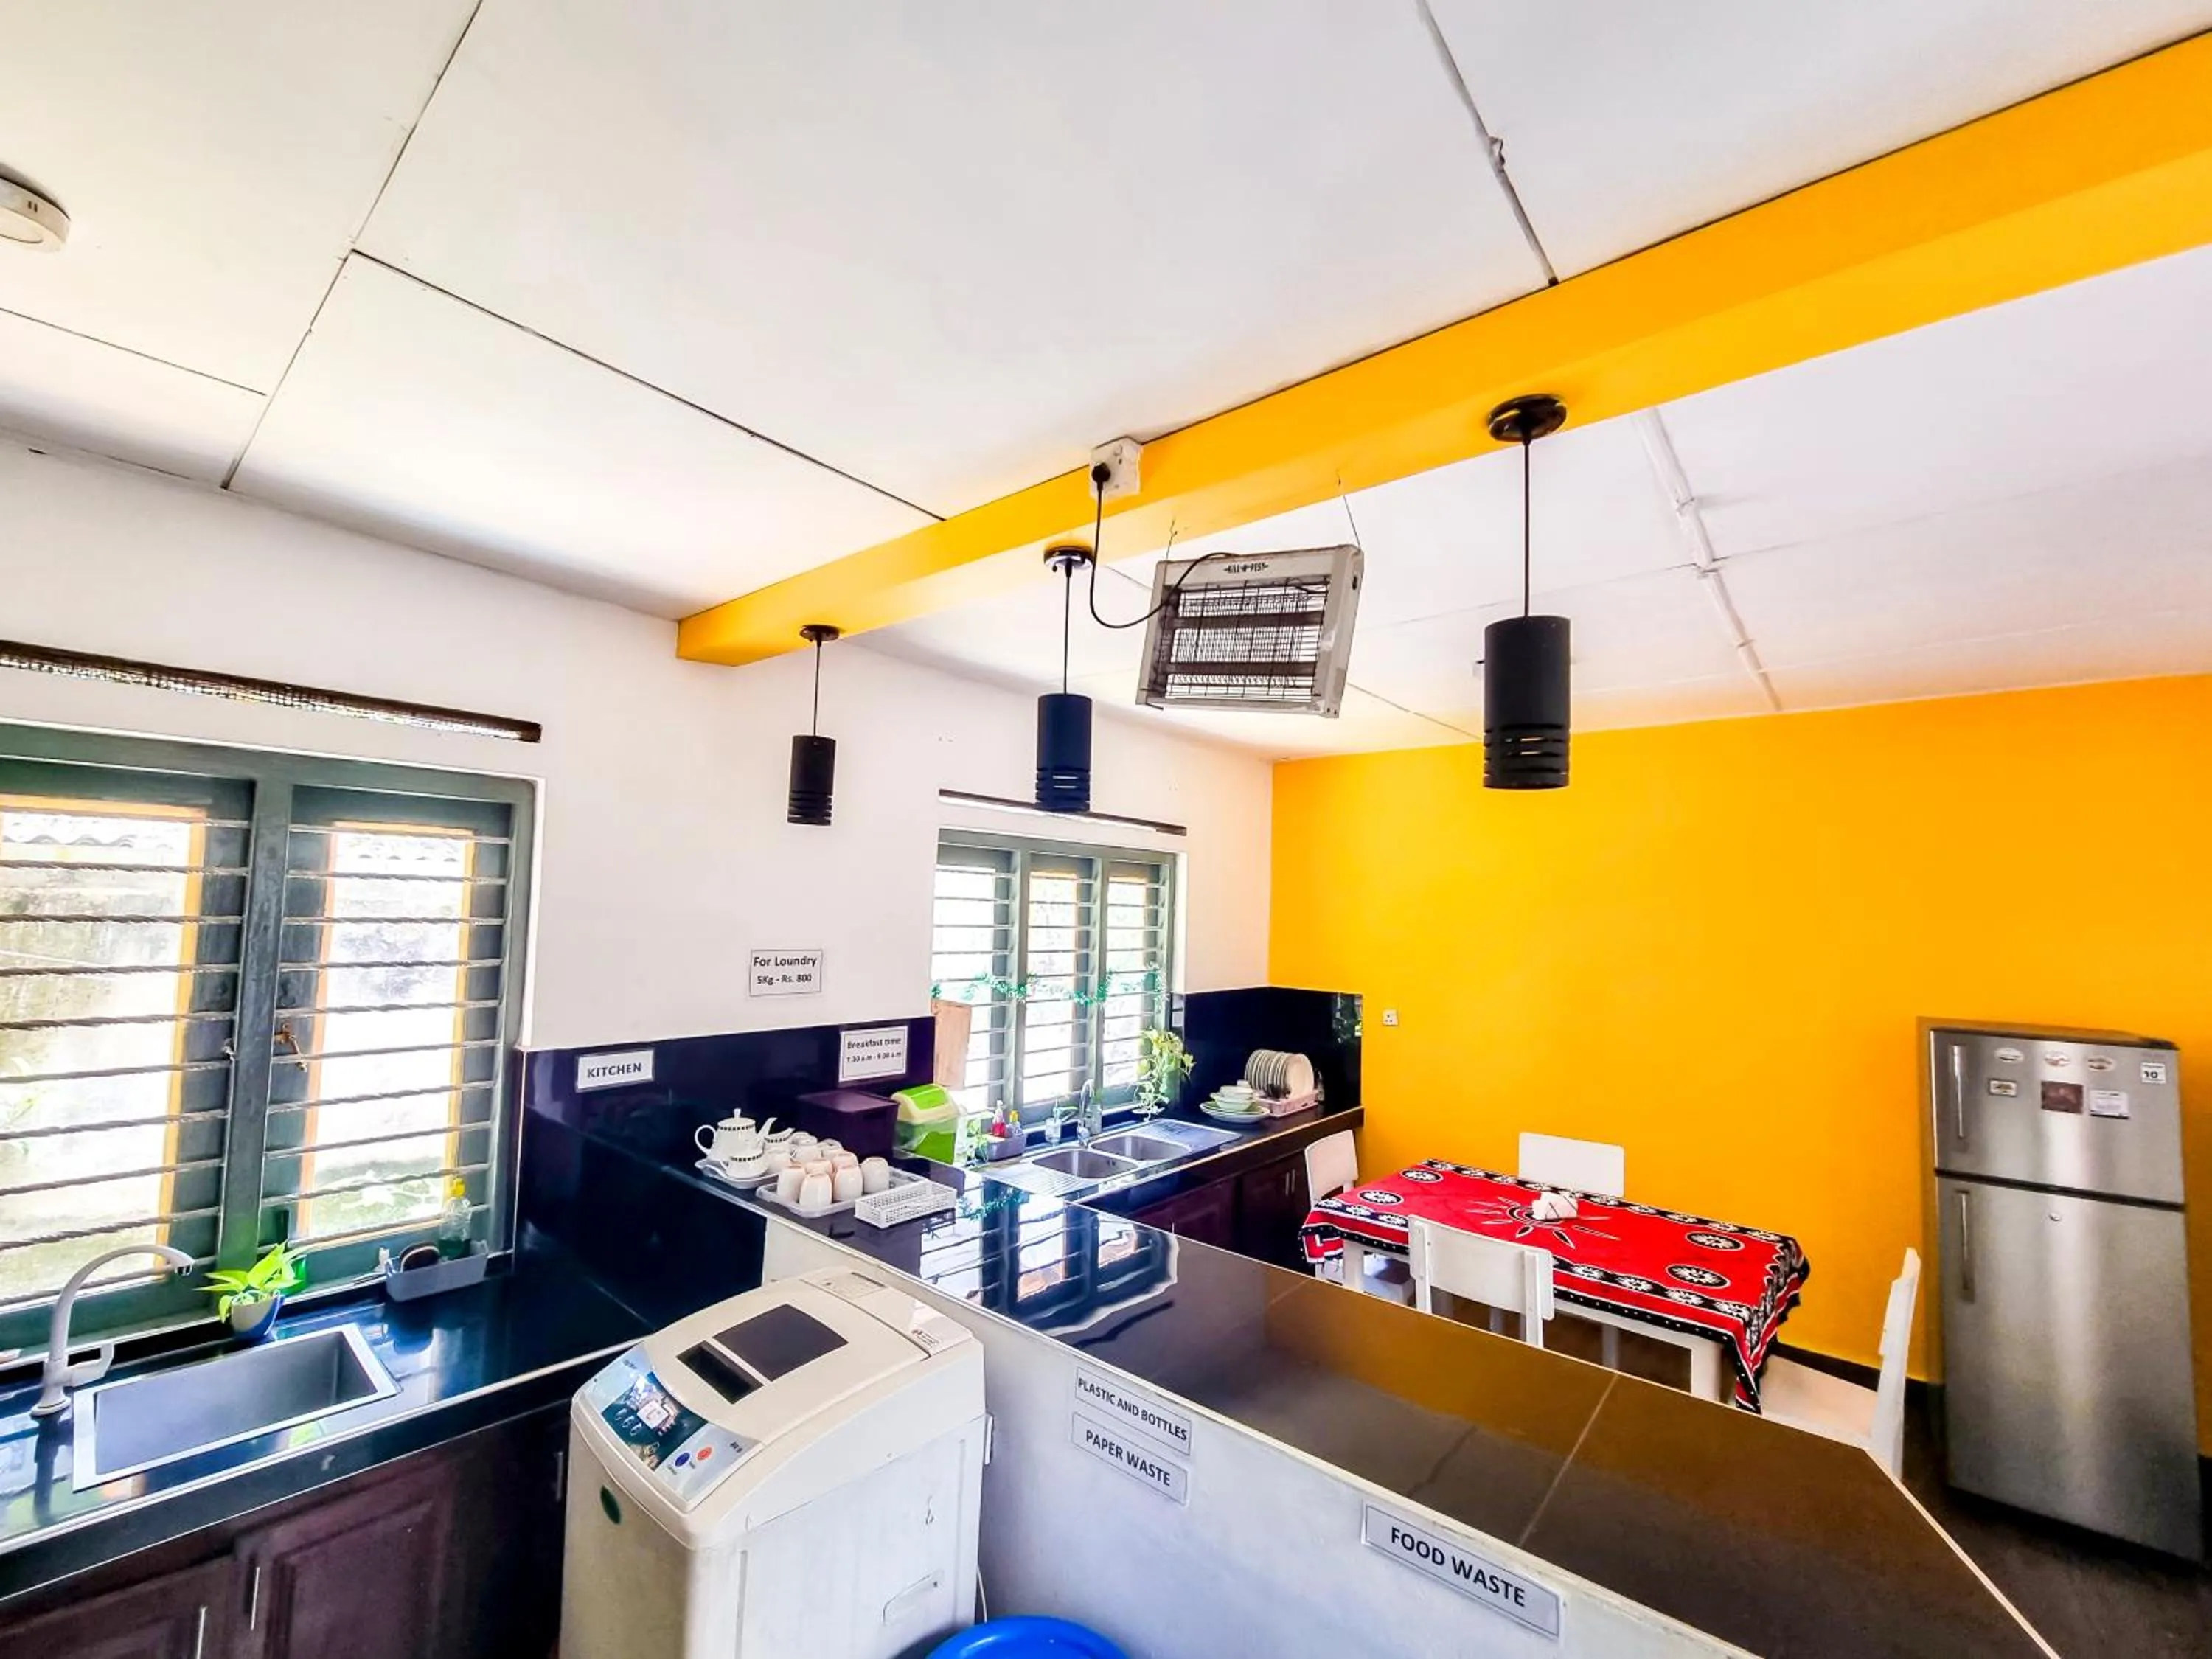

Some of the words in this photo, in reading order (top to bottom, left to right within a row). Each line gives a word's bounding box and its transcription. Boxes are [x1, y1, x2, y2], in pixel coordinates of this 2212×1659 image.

[754, 956, 771, 967] For
[774, 956, 817, 967] Loundry
[757, 975, 773, 986] 5Kg
[781, 974, 794, 983] Rs.
[796, 973, 812, 983] 800
[847, 1038, 883, 1049] Breakfast
[884, 1037, 901, 1046] time
[588, 1062, 641, 1079] KITCHEN
[1078, 1378, 1116, 1405] PLASTIC
[1117, 1398, 1139, 1416] AND
[1141, 1409, 1187, 1441] BOTTLES
[1086, 1430, 1123, 1461] PAPER
[1127, 1450, 1170, 1486] WASTE
[1391, 1527, 1445, 1565] FOOD
[1452, 1555, 1525, 1607] WASTE
